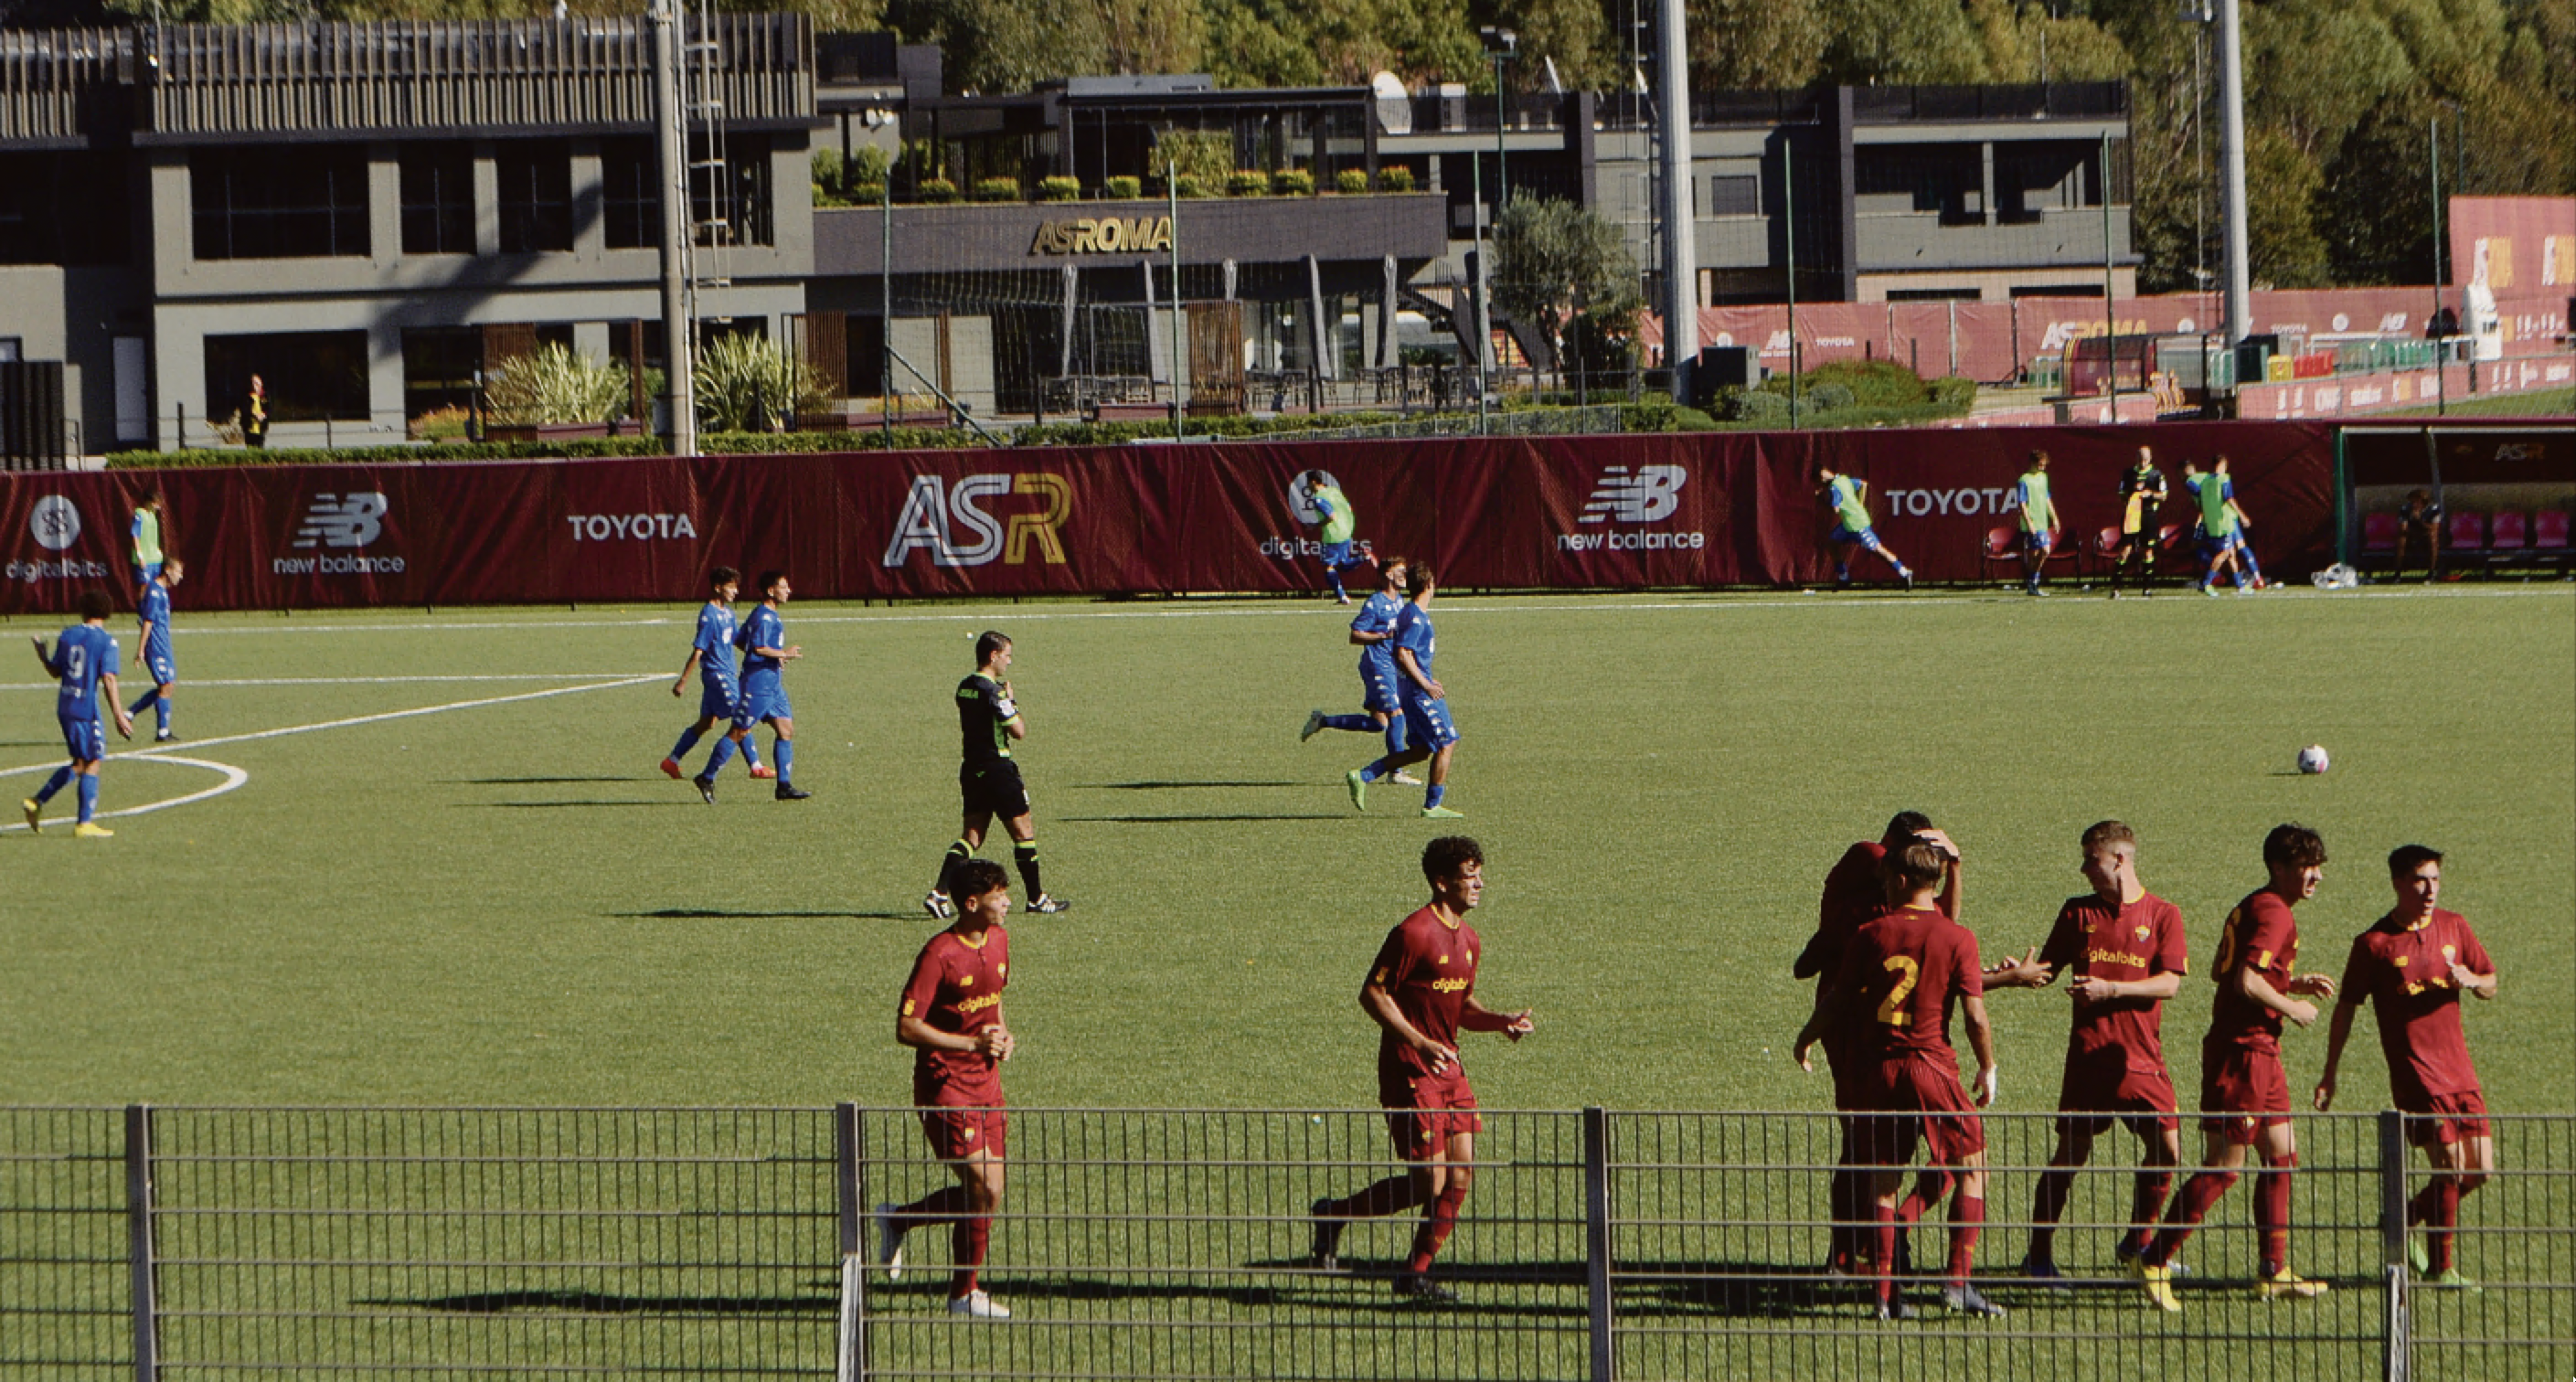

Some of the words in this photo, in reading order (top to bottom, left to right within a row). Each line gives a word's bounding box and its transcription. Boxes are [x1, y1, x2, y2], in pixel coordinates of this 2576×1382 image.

[1885, 488, 2018, 516] TOYOTA
[567, 513, 697, 541] TOYOTA
[883, 473, 1071, 567] ASR
[1557, 532, 1604, 550] new
[1609, 527, 1705, 550] balance
[5, 558, 109, 583] digitalbits
[273, 556, 315, 574] new
[320, 553, 405, 573] balance
[69, 644, 87, 678] 9
[1877, 955, 1919, 1026] 2
